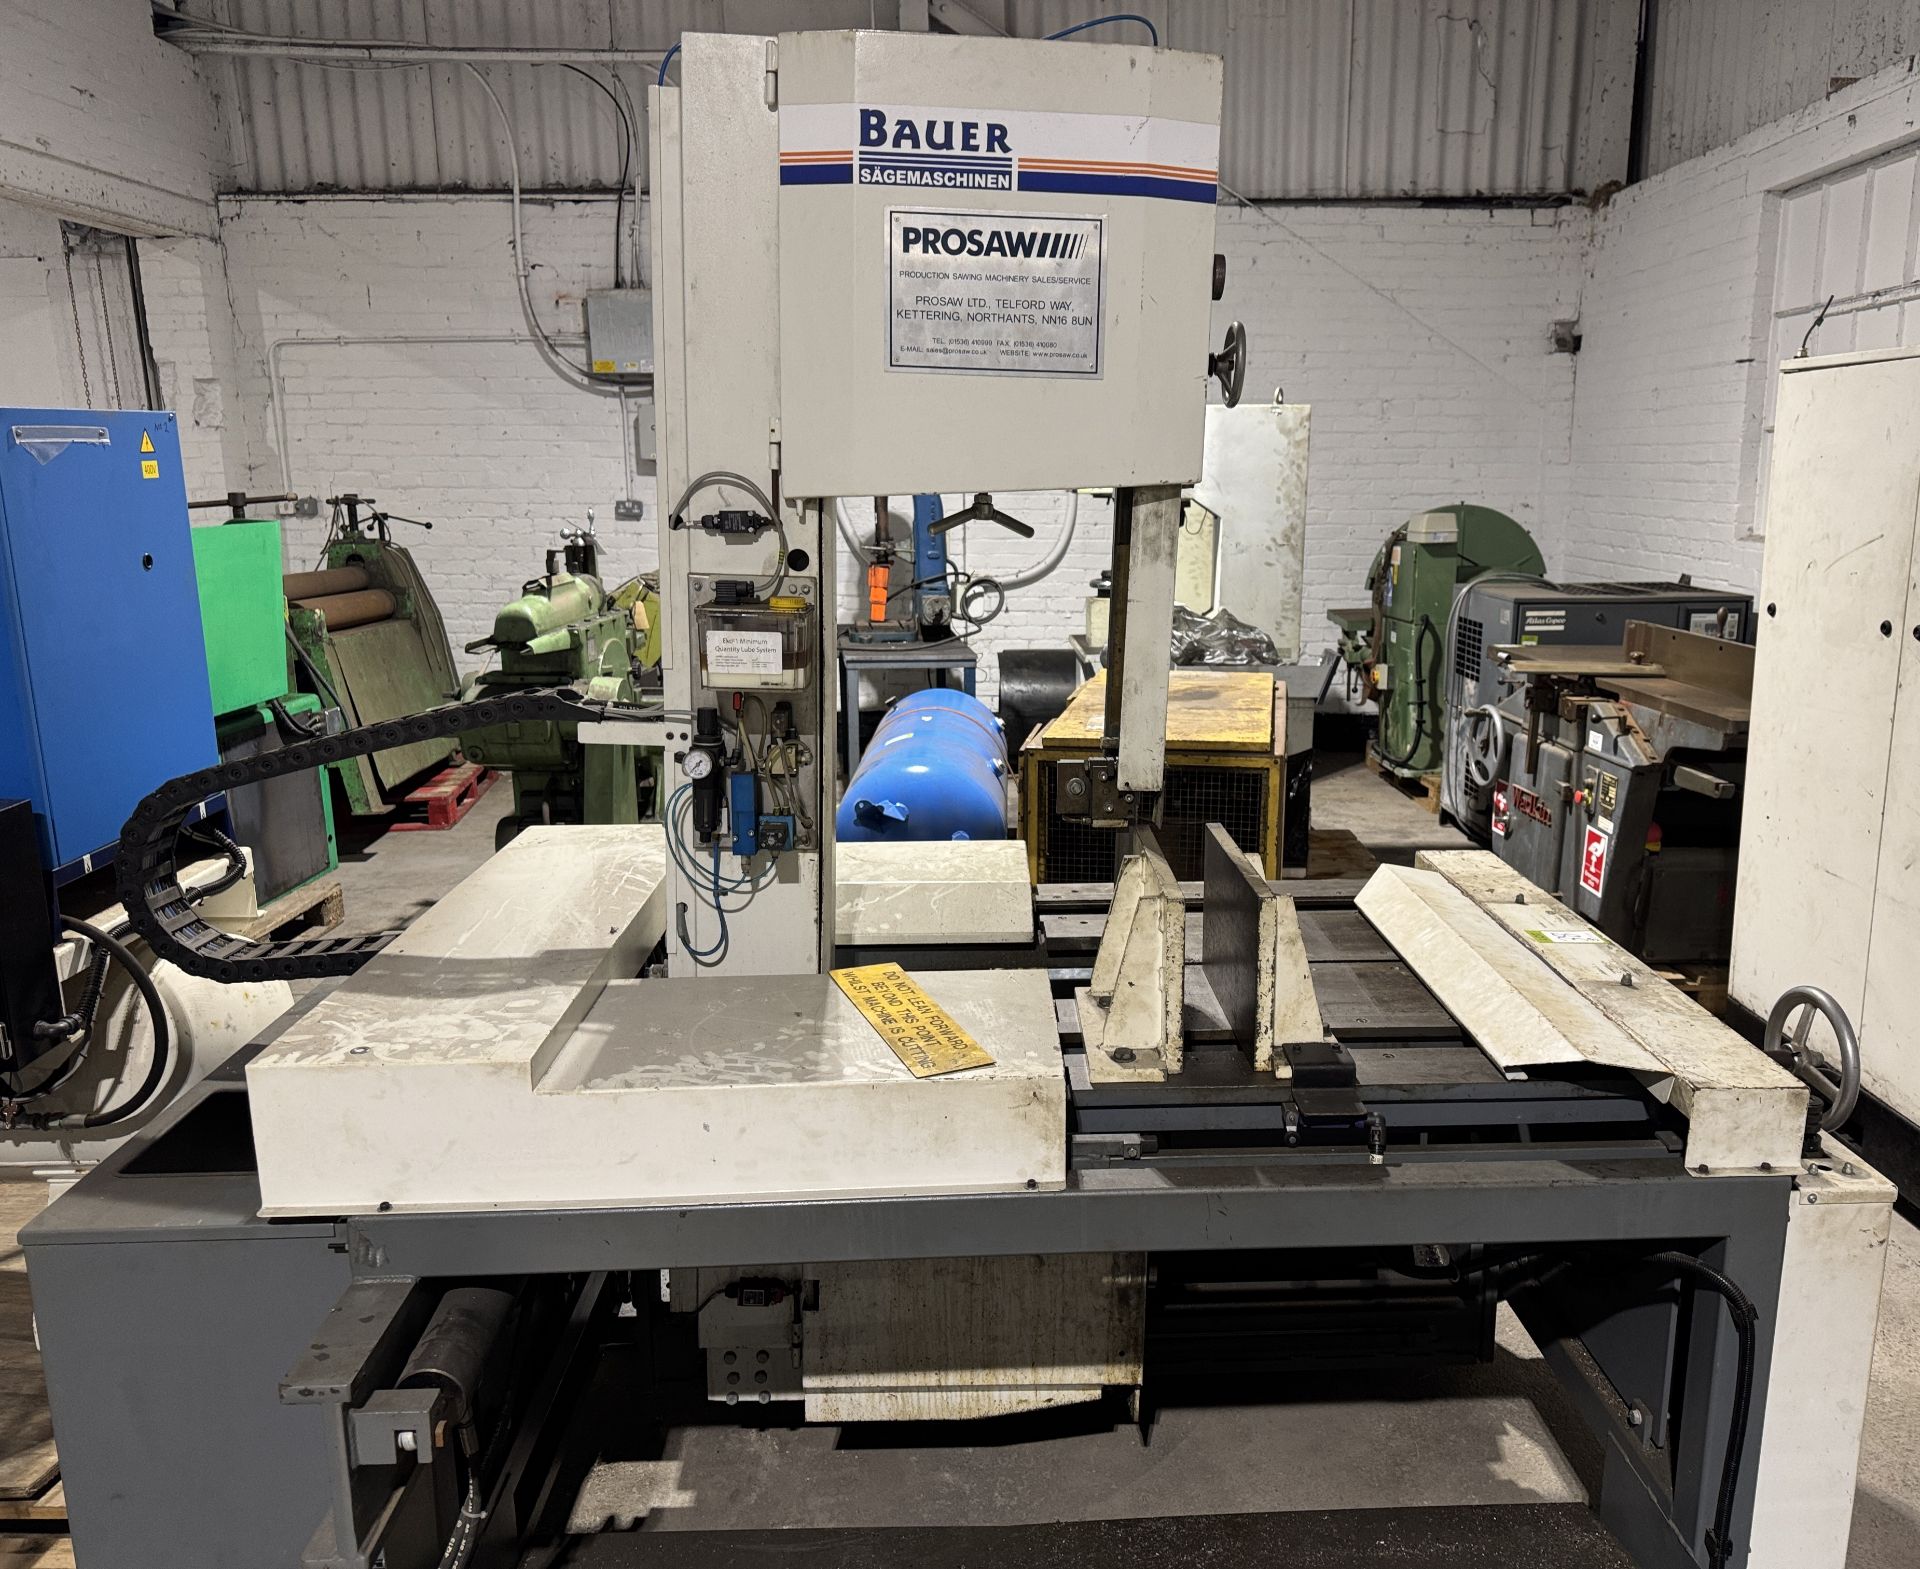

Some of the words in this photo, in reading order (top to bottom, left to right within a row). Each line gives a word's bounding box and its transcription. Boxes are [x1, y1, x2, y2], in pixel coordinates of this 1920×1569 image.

[859, 109, 1013, 153] BAUER
[860, 166, 1010, 189] SÄGEMASCHINEN
[902, 227, 1038, 258] PROSAW
[899, 270, 950, 280] PRODUCTION
[953, 272, 983, 281] SAWING
[985, 274, 1030, 283] MACHINERY
[1032, 276, 1091, 285] SALES/SERVICE
[896, 309, 963, 322] KETTERING,
[967, 312, 1038, 325] NORTHANTS,
[1042, 315, 1068, 325] NN16
[1071, 316, 1093, 326] 8UN
[915, 296, 963, 307] PROSAW
[995, 299, 1046, 310] TELFORD
[1050, 301, 1074, 312] WAY,
[841, 971, 873, 995] WHILST
[861, 996, 899, 1026] MACHINE
[870, 981, 903, 1007] BEYOND
[899, 1007, 920, 1025] THIS
[911, 1025, 943, 1047] POINT
[882, 971, 900, 982] DO
[893, 978, 916, 995] NOT
[907, 996, 933, 1014] LEAN
[925, 1016, 969, 1051] FORWARD
[889, 1023, 906, 1035] IS
[897, 1036, 937, 1070] CUTTING
